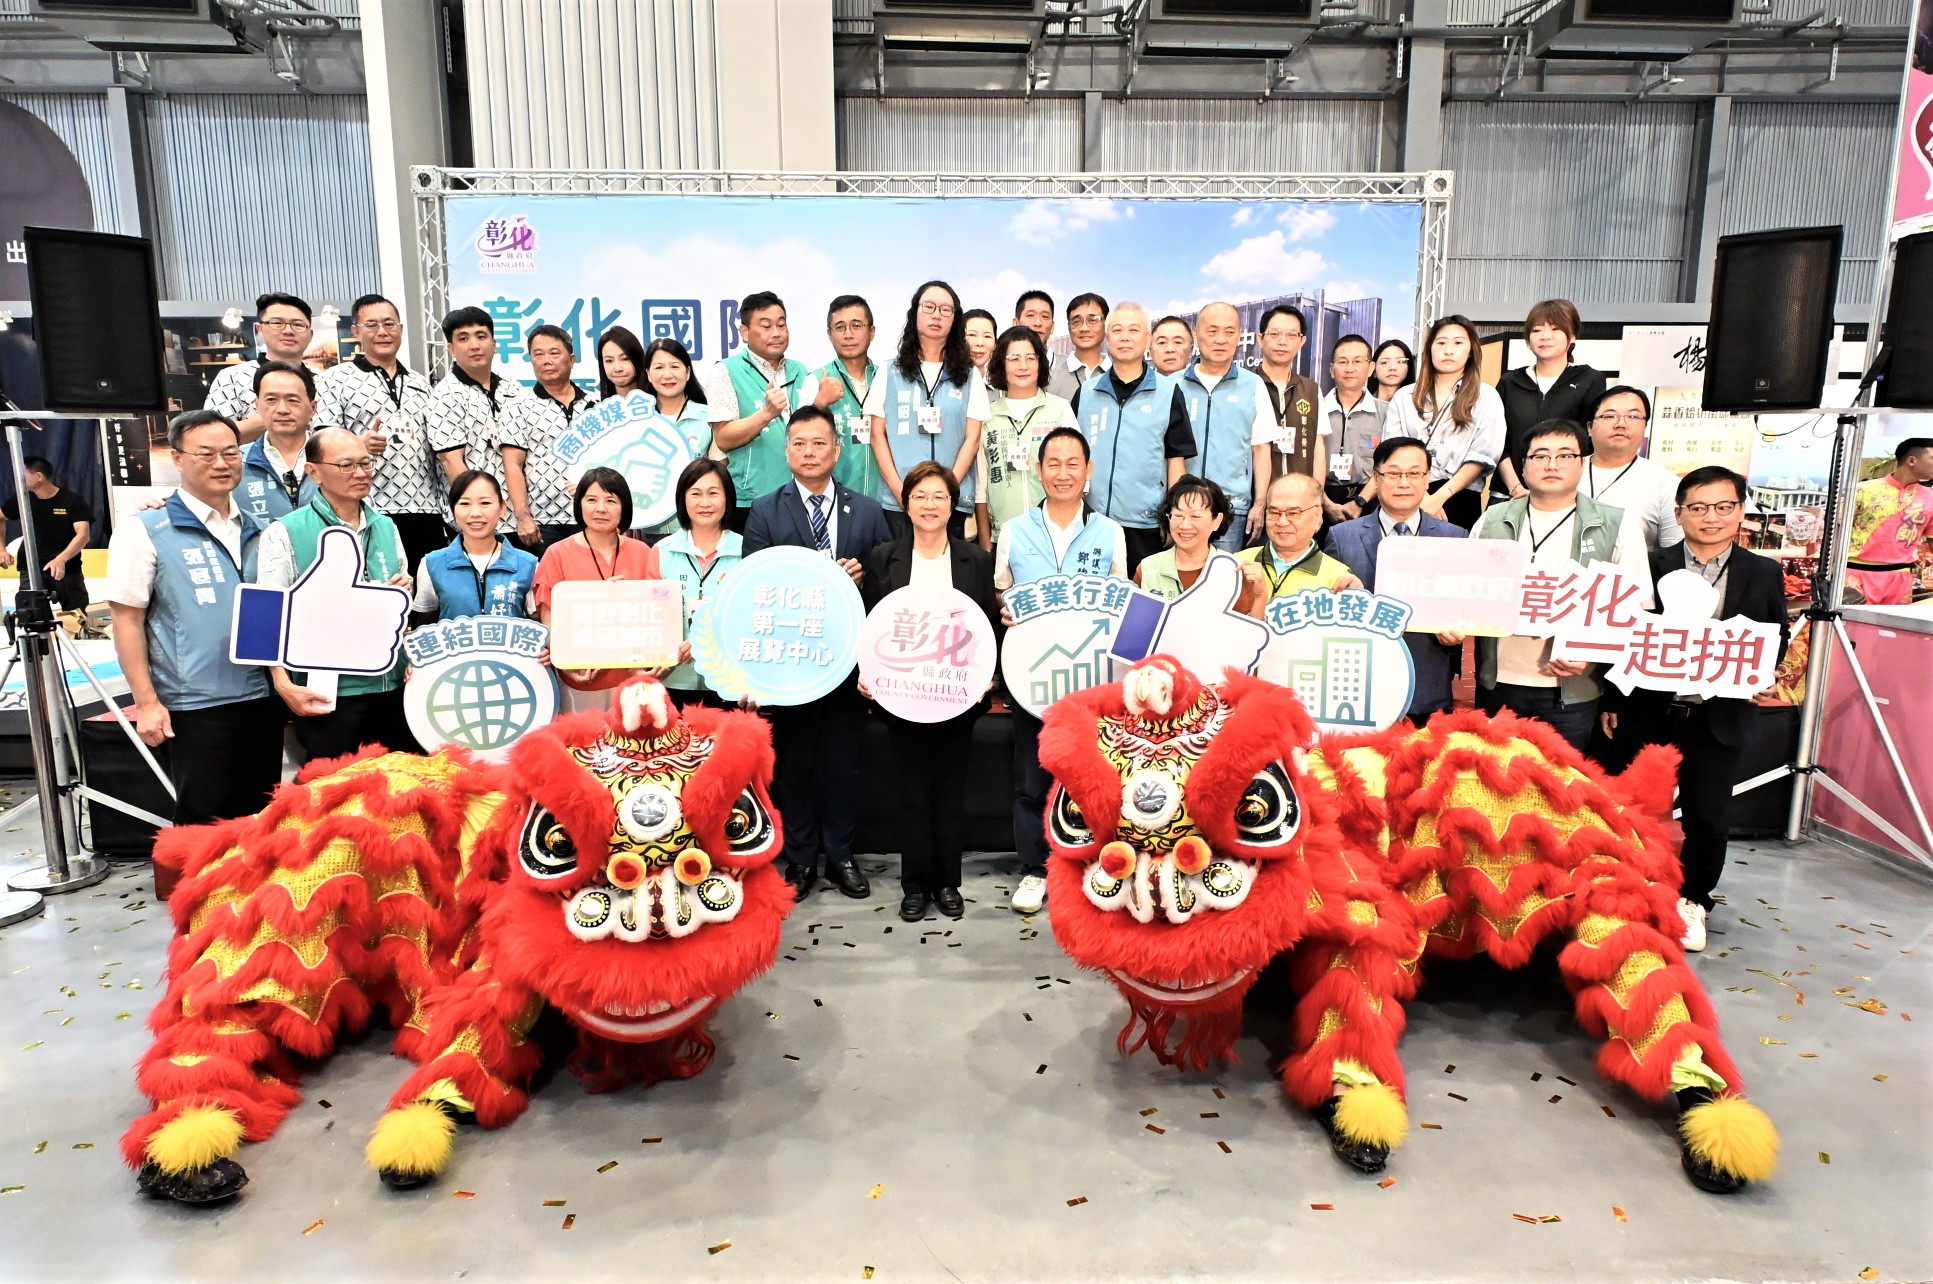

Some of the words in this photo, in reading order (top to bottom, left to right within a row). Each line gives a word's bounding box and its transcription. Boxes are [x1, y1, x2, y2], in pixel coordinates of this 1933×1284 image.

[6, 240, 27, 264] 出
[480, 261, 536, 269] CHANGHUA
[558, 395, 651, 460] 商機媒合
[986, 429, 1004, 484] 黃彩惠
[247, 480, 270, 524] 張立
[753, 583, 826, 610] 彰化縣
[1008, 579, 1130, 618] 產業行銷
[1268, 593, 1406, 634] 在地發展
[1519, 570, 1641, 628] 彰化
[752, 611, 825, 638] 第一座
[890, 607, 973, 667] 彰化
[406, 622, 544, 662] 連結國際
[739, 638, 835, 667] 展覽中心
[875, 677, 969, 697] CHANGHUA
[922, 665, 970, 682] 縣政府
[875, 689, 910, 700] COUNTY
[911, 692, 968, 705] GOVERNMENT
